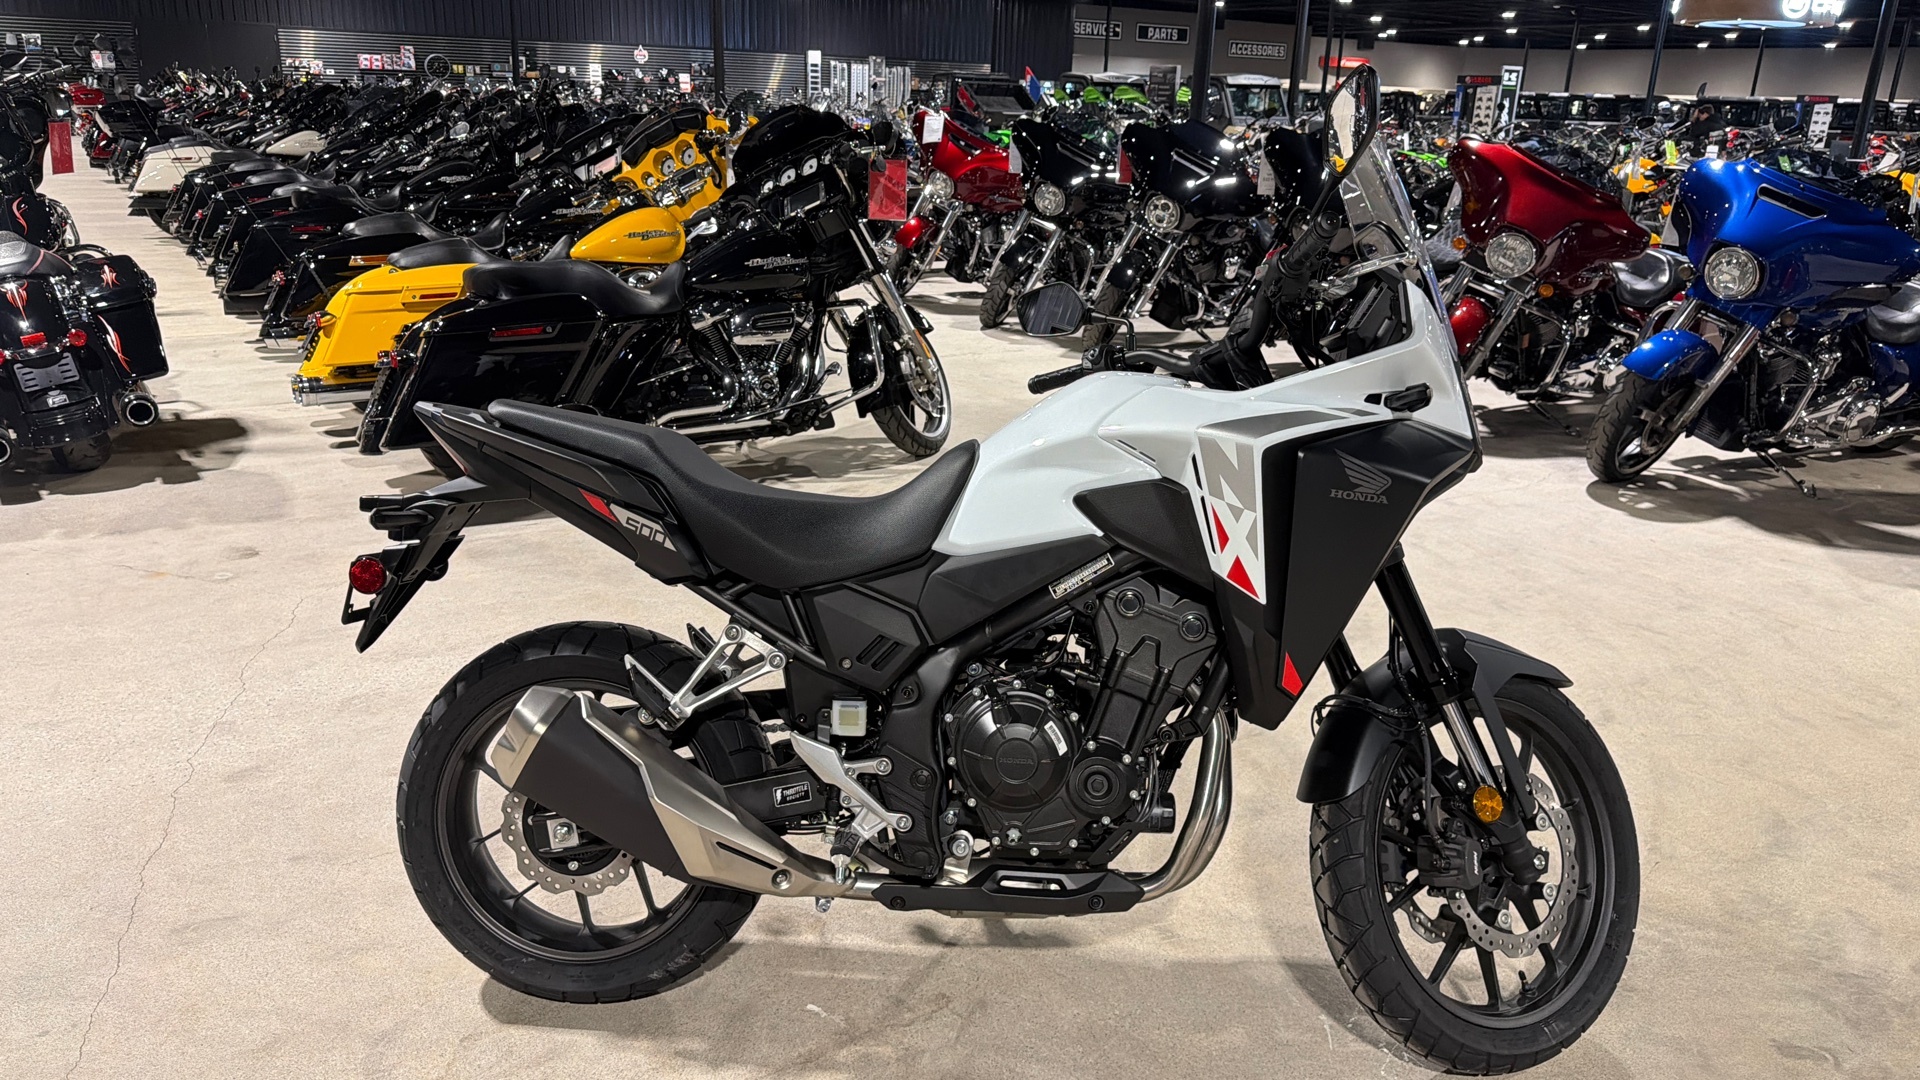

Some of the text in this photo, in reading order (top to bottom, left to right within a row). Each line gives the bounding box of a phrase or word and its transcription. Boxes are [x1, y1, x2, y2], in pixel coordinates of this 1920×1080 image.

[1074, 22, 1114, 36] SERVICE
[1148, 27, 1178, 40] PARTS
[1230, 44, 1285, 56] ACCESSORIES
[1329, 489, 1389, 504] HONDA
[625, 516, 667, 546] 500
[999, 757, 1035, 765] HONDA
